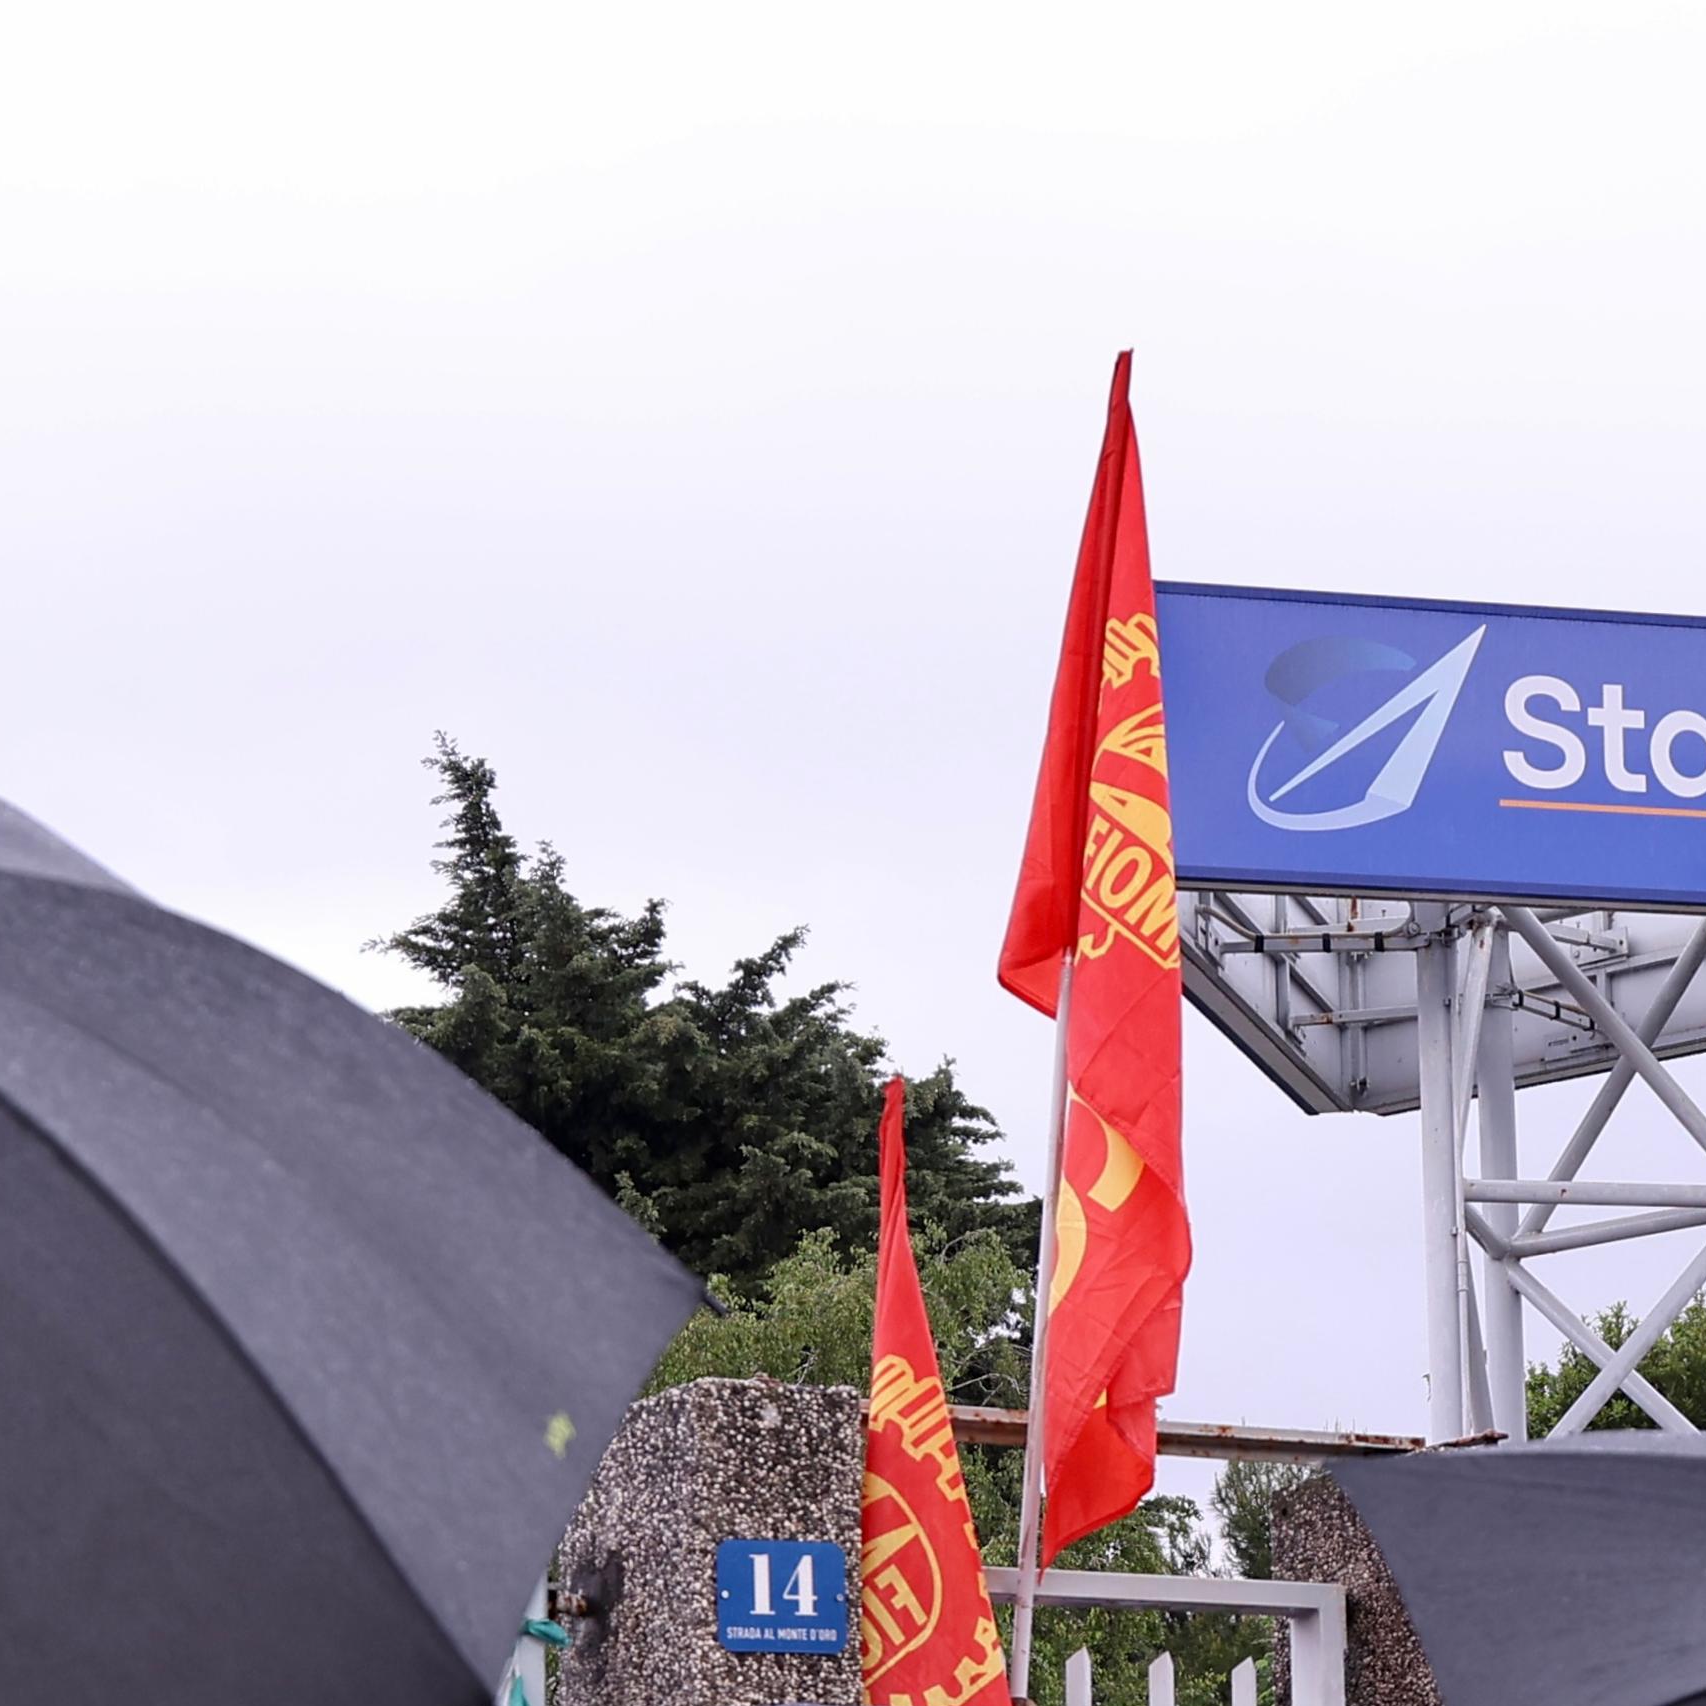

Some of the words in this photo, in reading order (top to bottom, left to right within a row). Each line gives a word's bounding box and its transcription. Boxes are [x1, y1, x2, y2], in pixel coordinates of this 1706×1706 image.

[1083, 815, 1178, 953] FIOM
[749, 1553, 818, 1617] 14
[726, 1626, 762, 1640] STRADA
[763, 1627, 775, 1640] AL
[777, 1627, 808, 1641] MONTE
